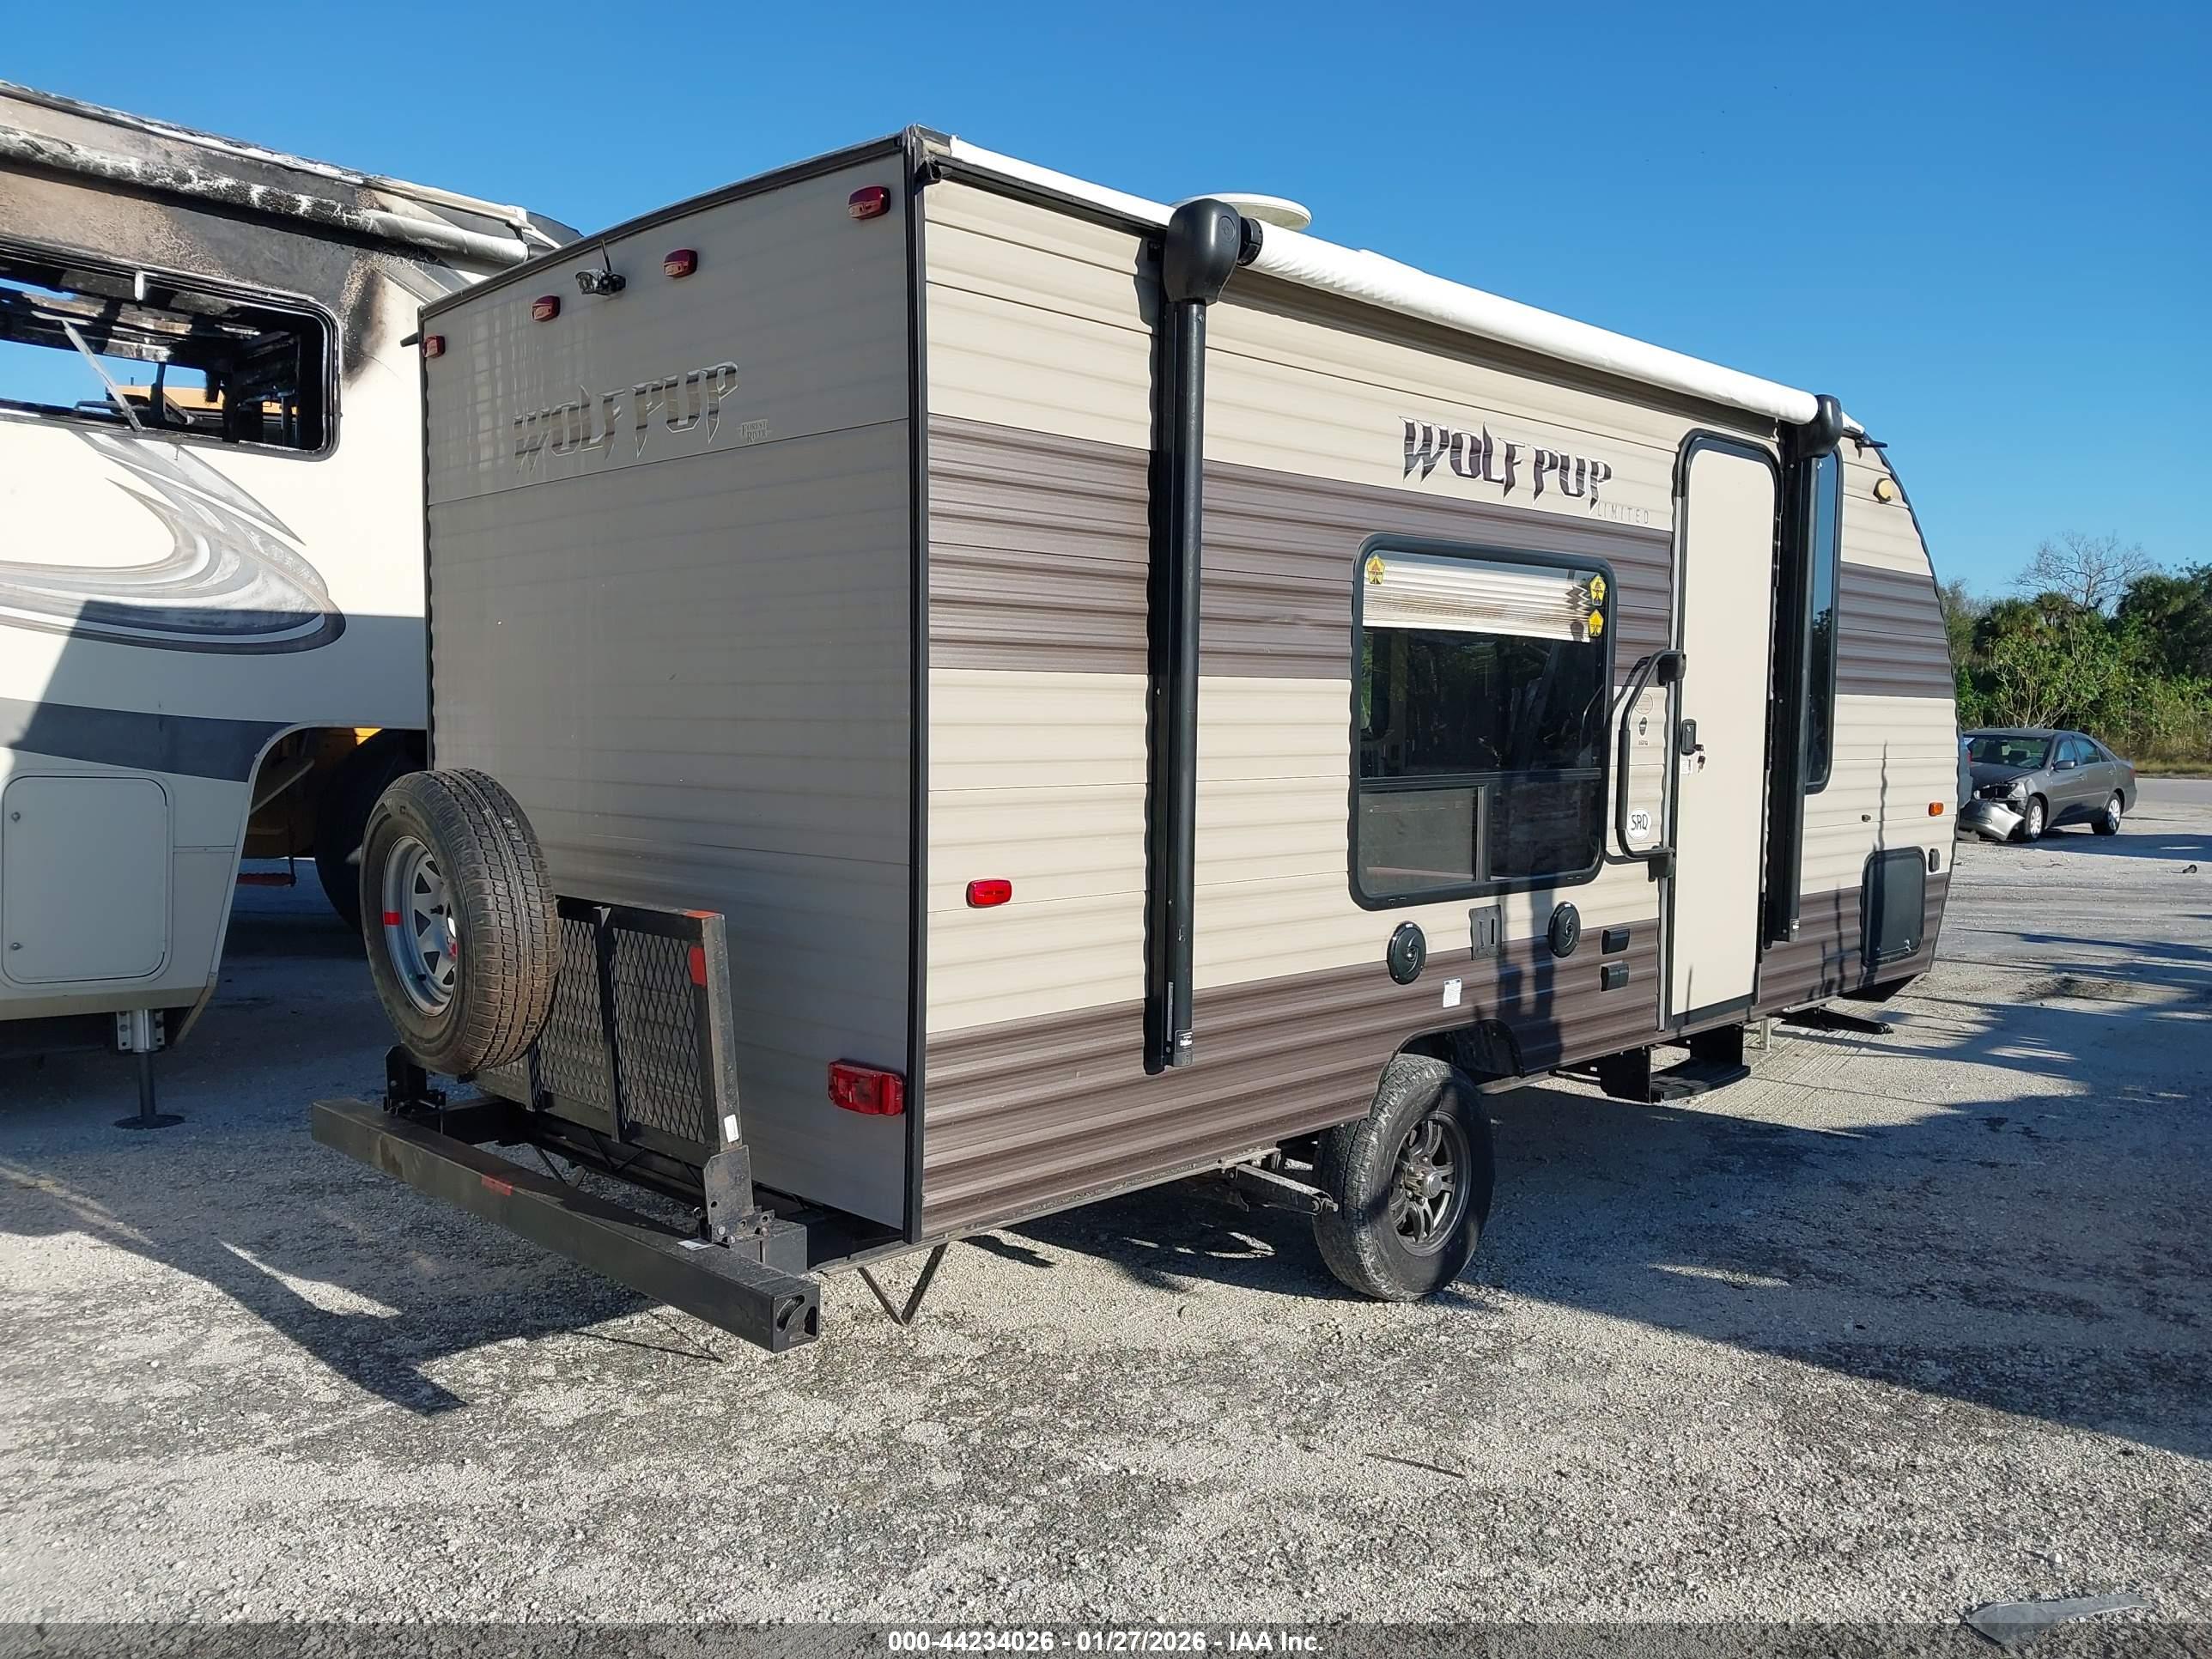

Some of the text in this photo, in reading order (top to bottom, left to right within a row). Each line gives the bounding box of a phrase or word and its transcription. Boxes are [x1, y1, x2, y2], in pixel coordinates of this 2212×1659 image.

[514, 361, 738, 474] WOLF PUP
[1398, 416, 1613, 515] WOLF PUP
[1598, 501, 1650, 525] LIMITED
[1631, 814, 1648, 830] SRQ
